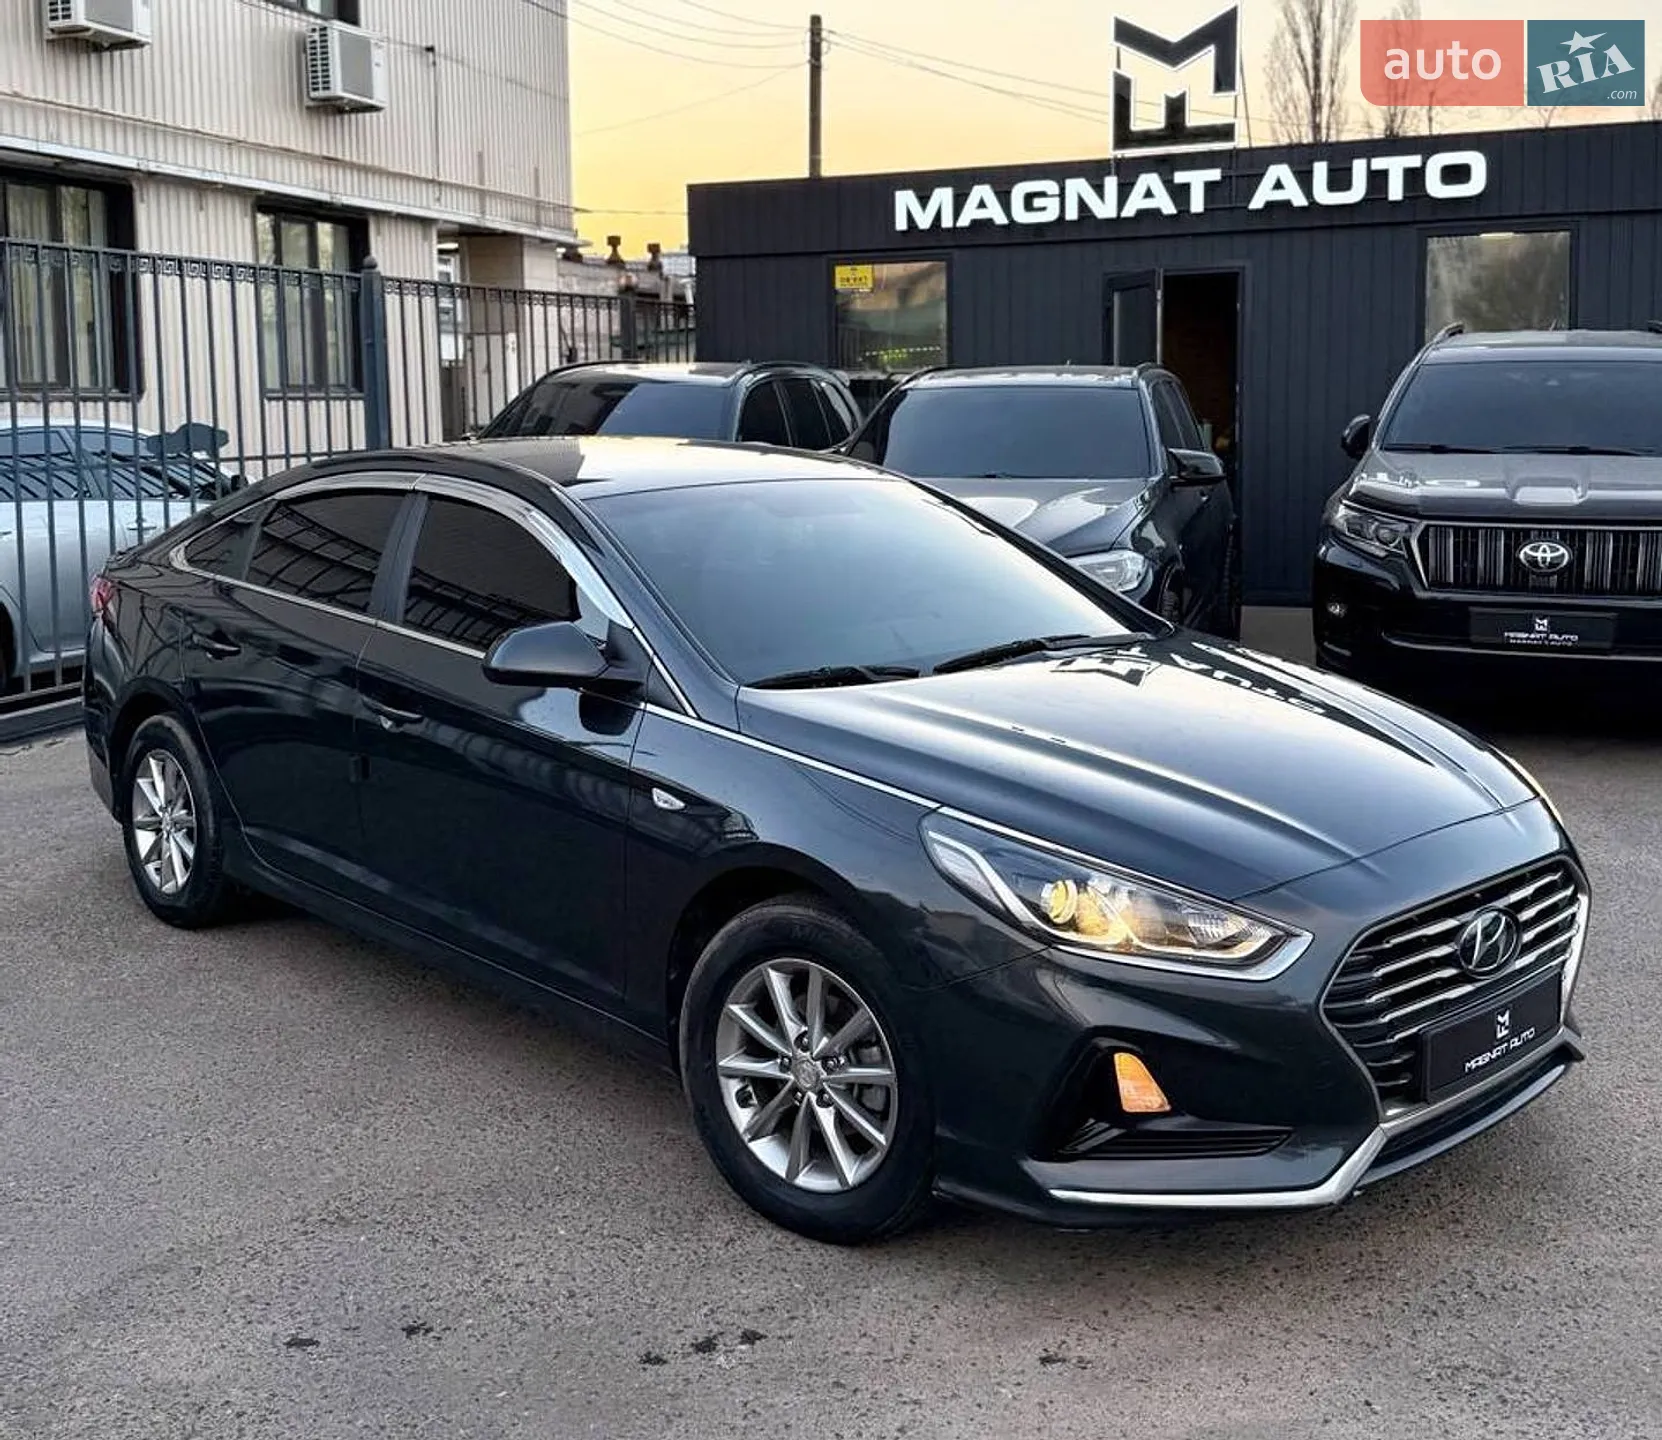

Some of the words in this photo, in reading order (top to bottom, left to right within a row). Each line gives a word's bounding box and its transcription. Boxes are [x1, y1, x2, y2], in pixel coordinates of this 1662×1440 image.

[895, 168, 1222, 231] MAGNAT
[1248, 151, 1487, 209] AUTO
[1465, 1042, 1508, 1072] MAGNAT
[1510, 1027, 1535, 1049] AUTO
